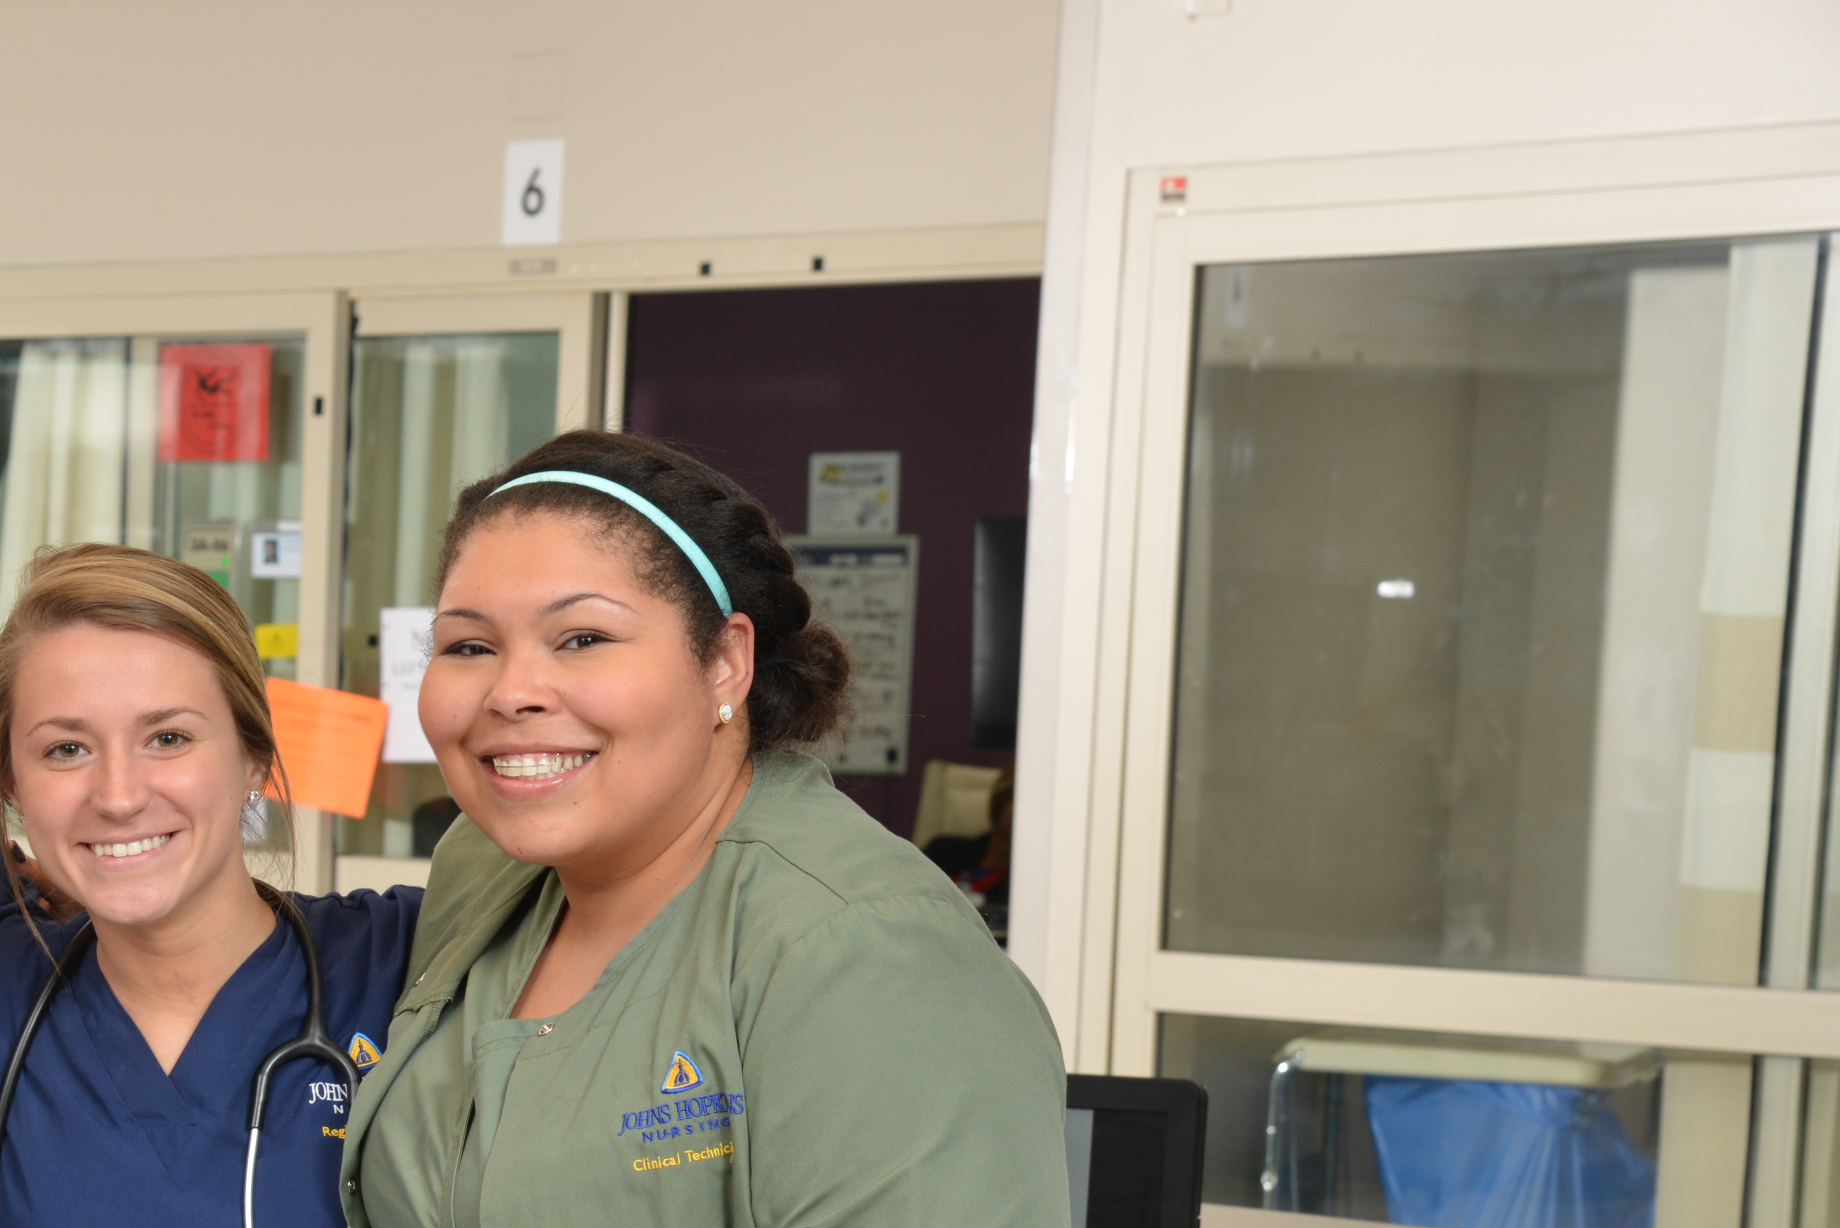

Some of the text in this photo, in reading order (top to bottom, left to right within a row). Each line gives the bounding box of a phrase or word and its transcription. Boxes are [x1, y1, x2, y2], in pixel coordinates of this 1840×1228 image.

[521, 166, 545, 216] 6
[308, 1081, 348, 1104] JOHN
[617, 1103, 673, 1136] JOHNS
[642, 1117, 731, 1143] NURSING
[633, 1152, 681, 1171] Clinical
